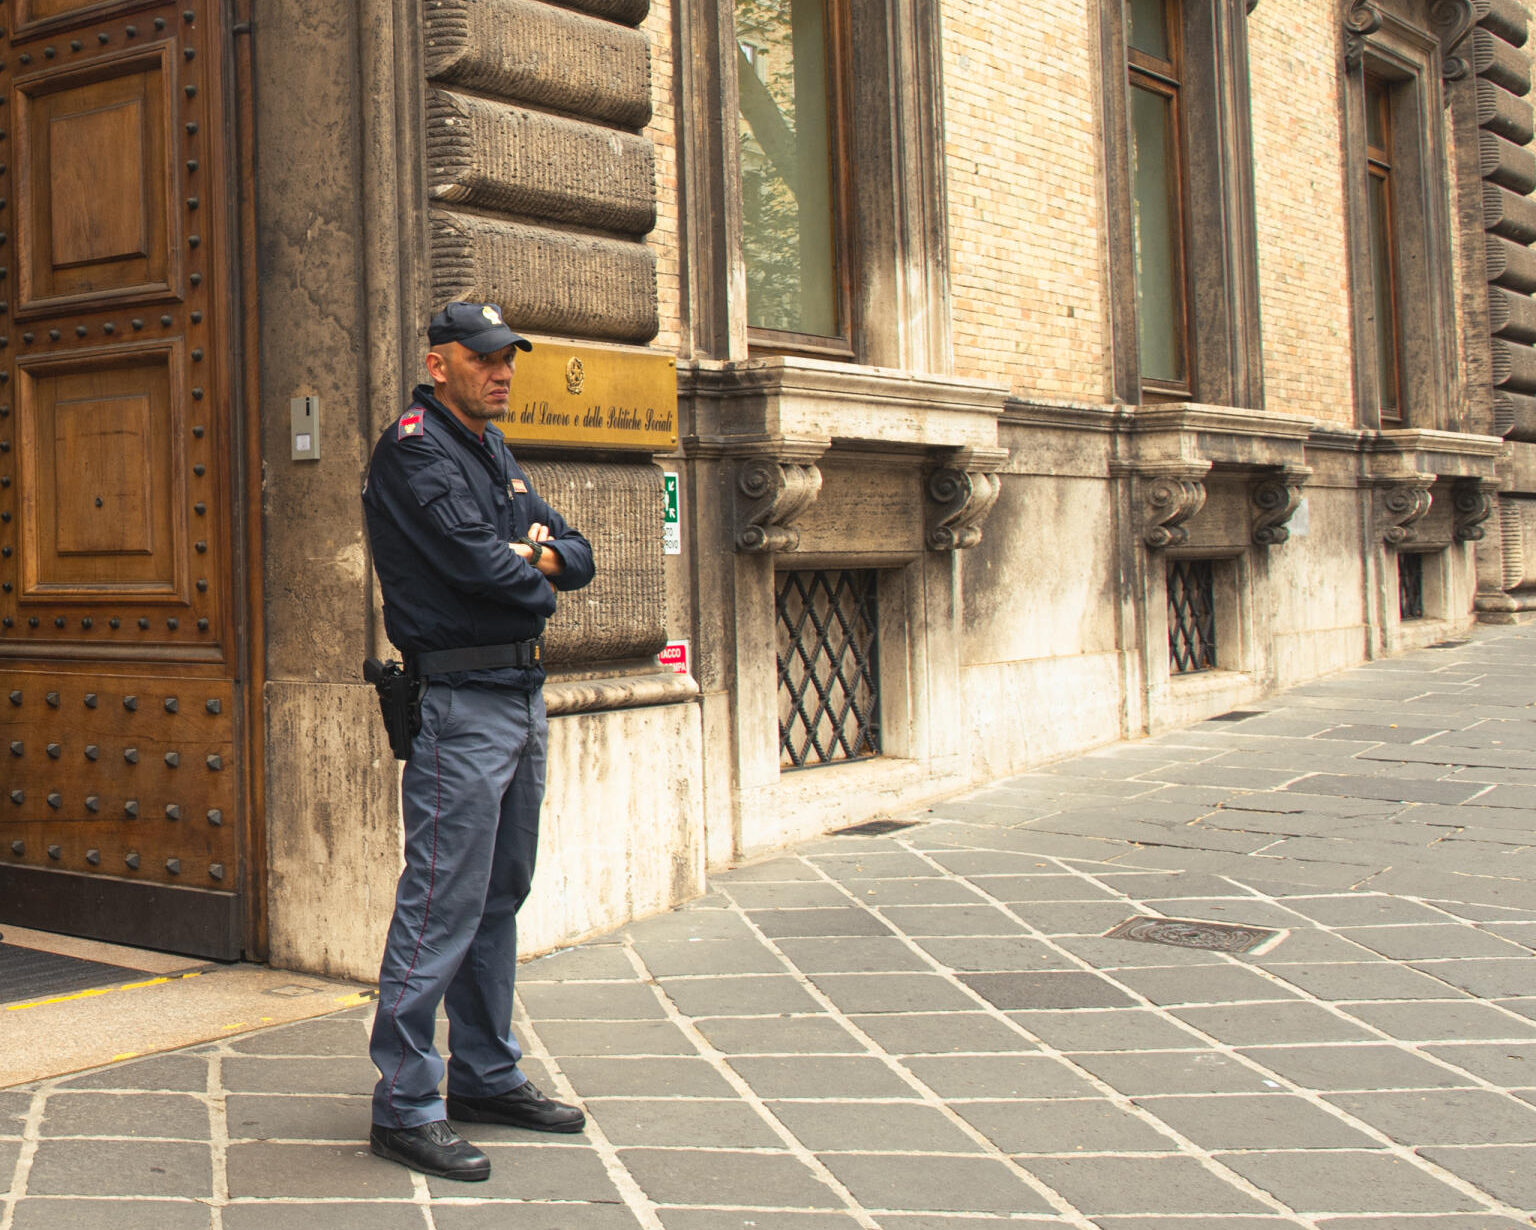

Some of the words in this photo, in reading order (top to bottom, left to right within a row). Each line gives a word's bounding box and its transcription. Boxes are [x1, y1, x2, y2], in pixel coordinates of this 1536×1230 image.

[520, 401, 536, 424] del
[574, 414, 580, 427] e
[582, 406, 603, 429] delle
[607, 406, 642, 431] Politiche
[645, 408, 673, 433] Sociali
